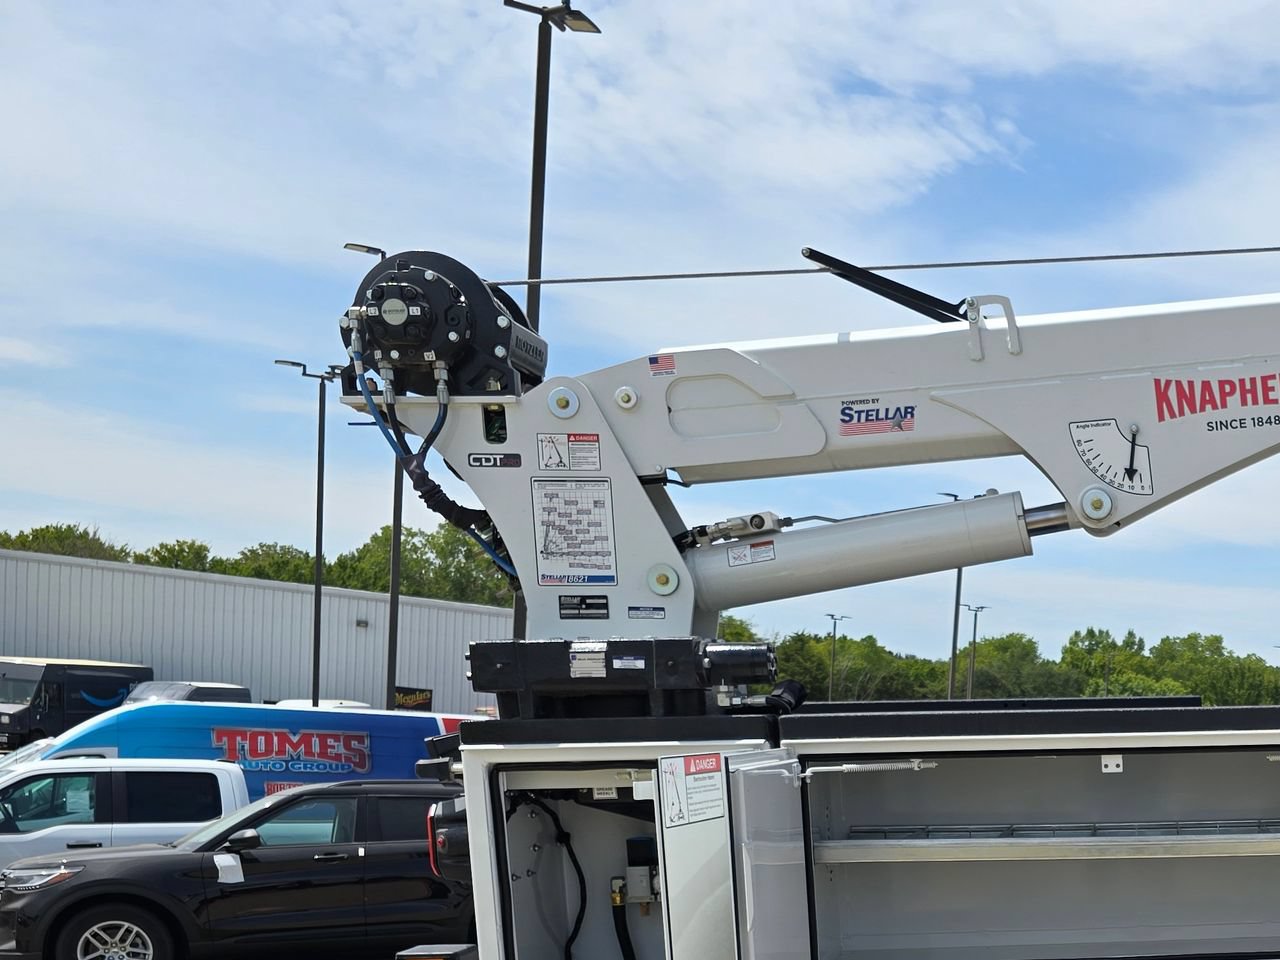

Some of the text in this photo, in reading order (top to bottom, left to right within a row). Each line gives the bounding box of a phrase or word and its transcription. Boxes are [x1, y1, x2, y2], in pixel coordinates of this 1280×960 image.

[841, 399, 871, 407] POWERED
[840, 405, 916, 424] STELLAR
[1206, 418, 1247, 432] SINCE
[568, 575, 588, 583] 8621
[212, 728, 371, 773] TOMES
[238, 760, 354, 773] AUTO GROUP
[695, 758, 717, 770] DANGER
